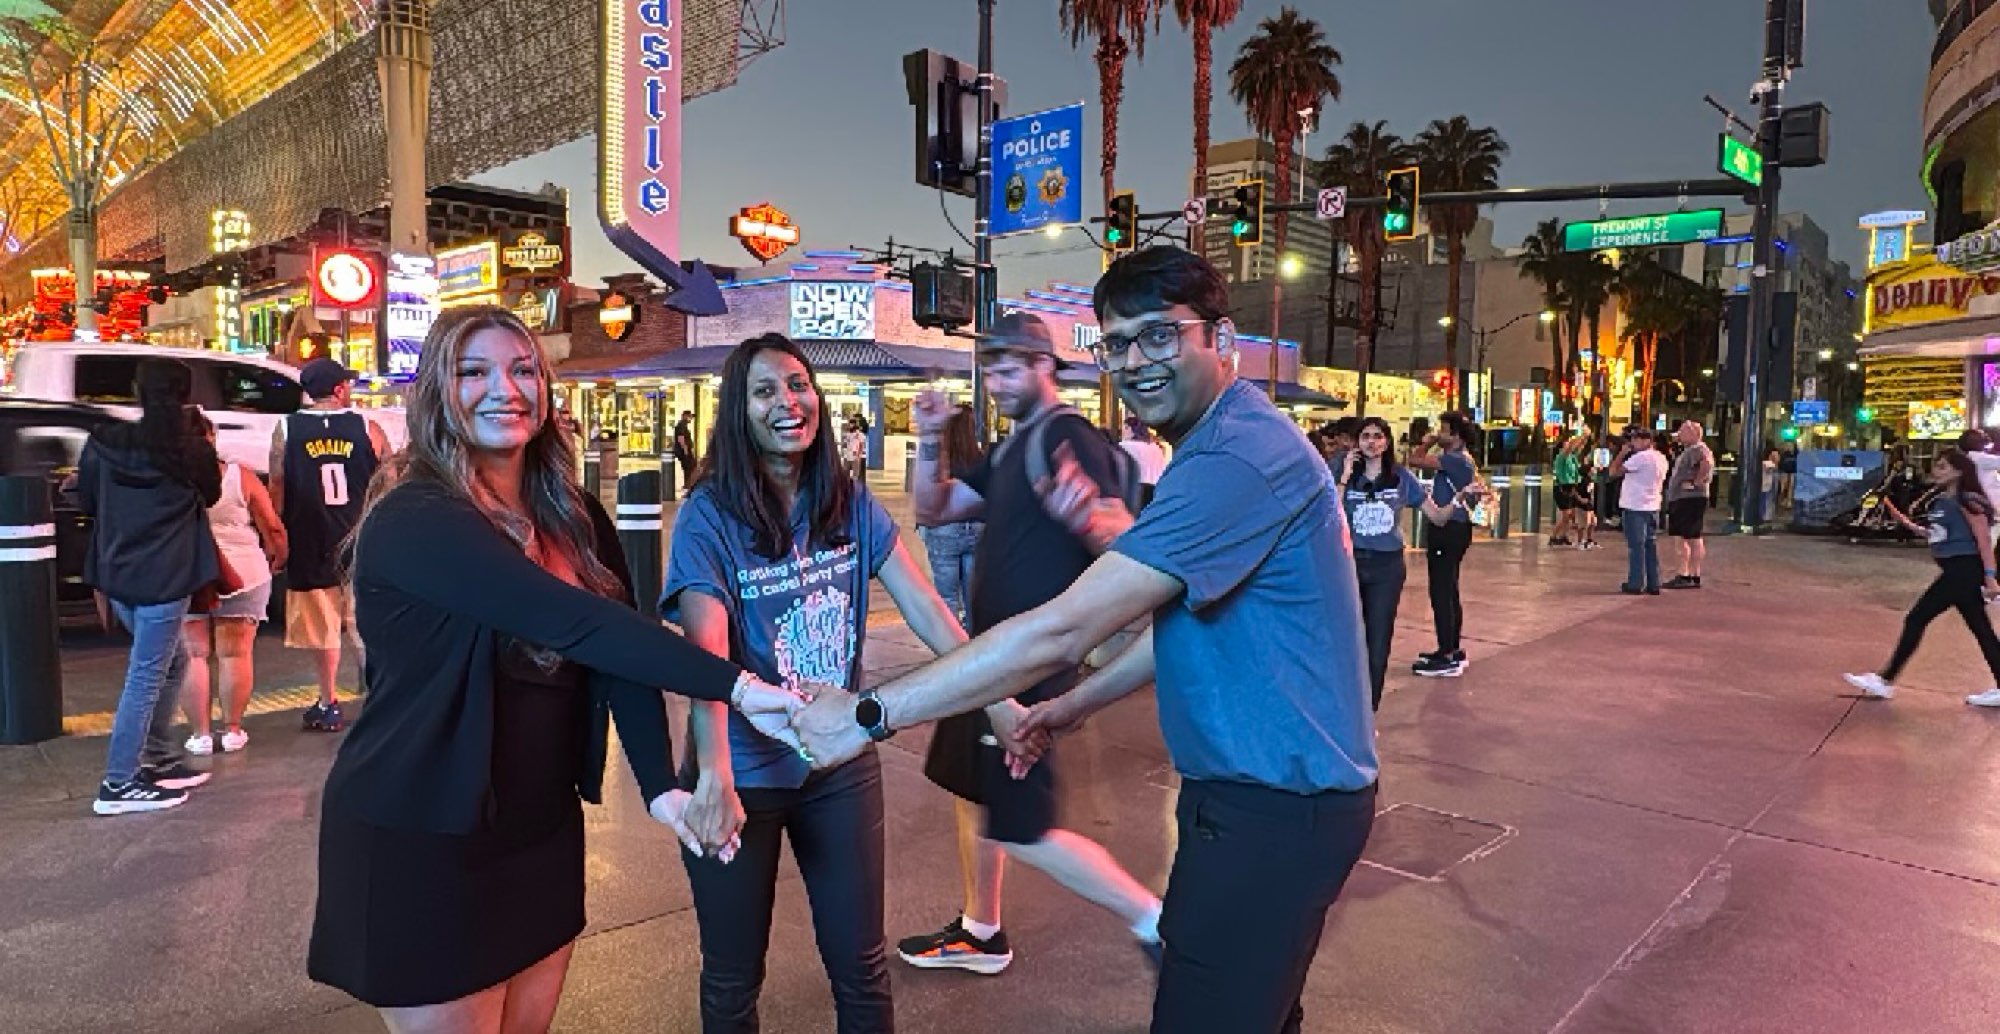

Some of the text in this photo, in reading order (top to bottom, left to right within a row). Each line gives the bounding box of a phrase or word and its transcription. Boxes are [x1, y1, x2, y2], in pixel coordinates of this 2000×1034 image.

[1002, 129, 1071, 160] POLICE
[1592, 215, 1669, 233] FREMONT ST
[1591, 230, 1670, 247] EXPERIENCE
[799, 284, 868, 302] NOW
[792, 301, 872, 320] OPEN
[800, 319, 867, 337] 24/7
[321, 463, 350, 506] 0
